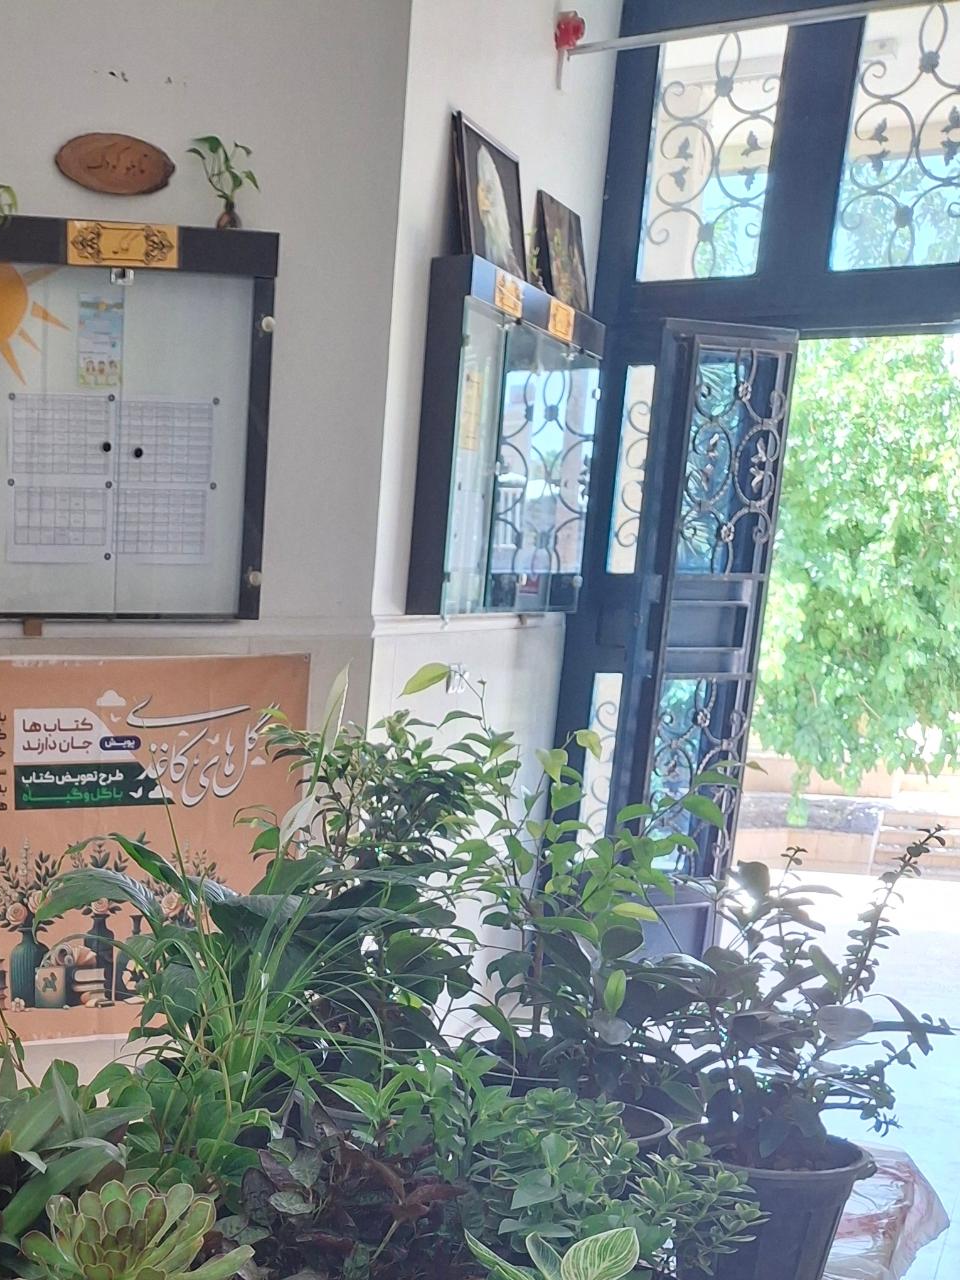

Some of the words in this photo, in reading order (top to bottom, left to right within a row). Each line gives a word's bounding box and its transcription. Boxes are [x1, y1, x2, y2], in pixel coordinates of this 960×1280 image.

[22, 718, 42, 733] ها
[44, 717, 93, 737] کتاب
[22, 736, 57, 755] دارند
[59, 736, 93, 754] جان
[104, 738, 136, 749] پویش
[21, 771, 55, 787] کتاب
[56, 771, 98, 786] تعویض
[99, 769, 124, 785] طرح
